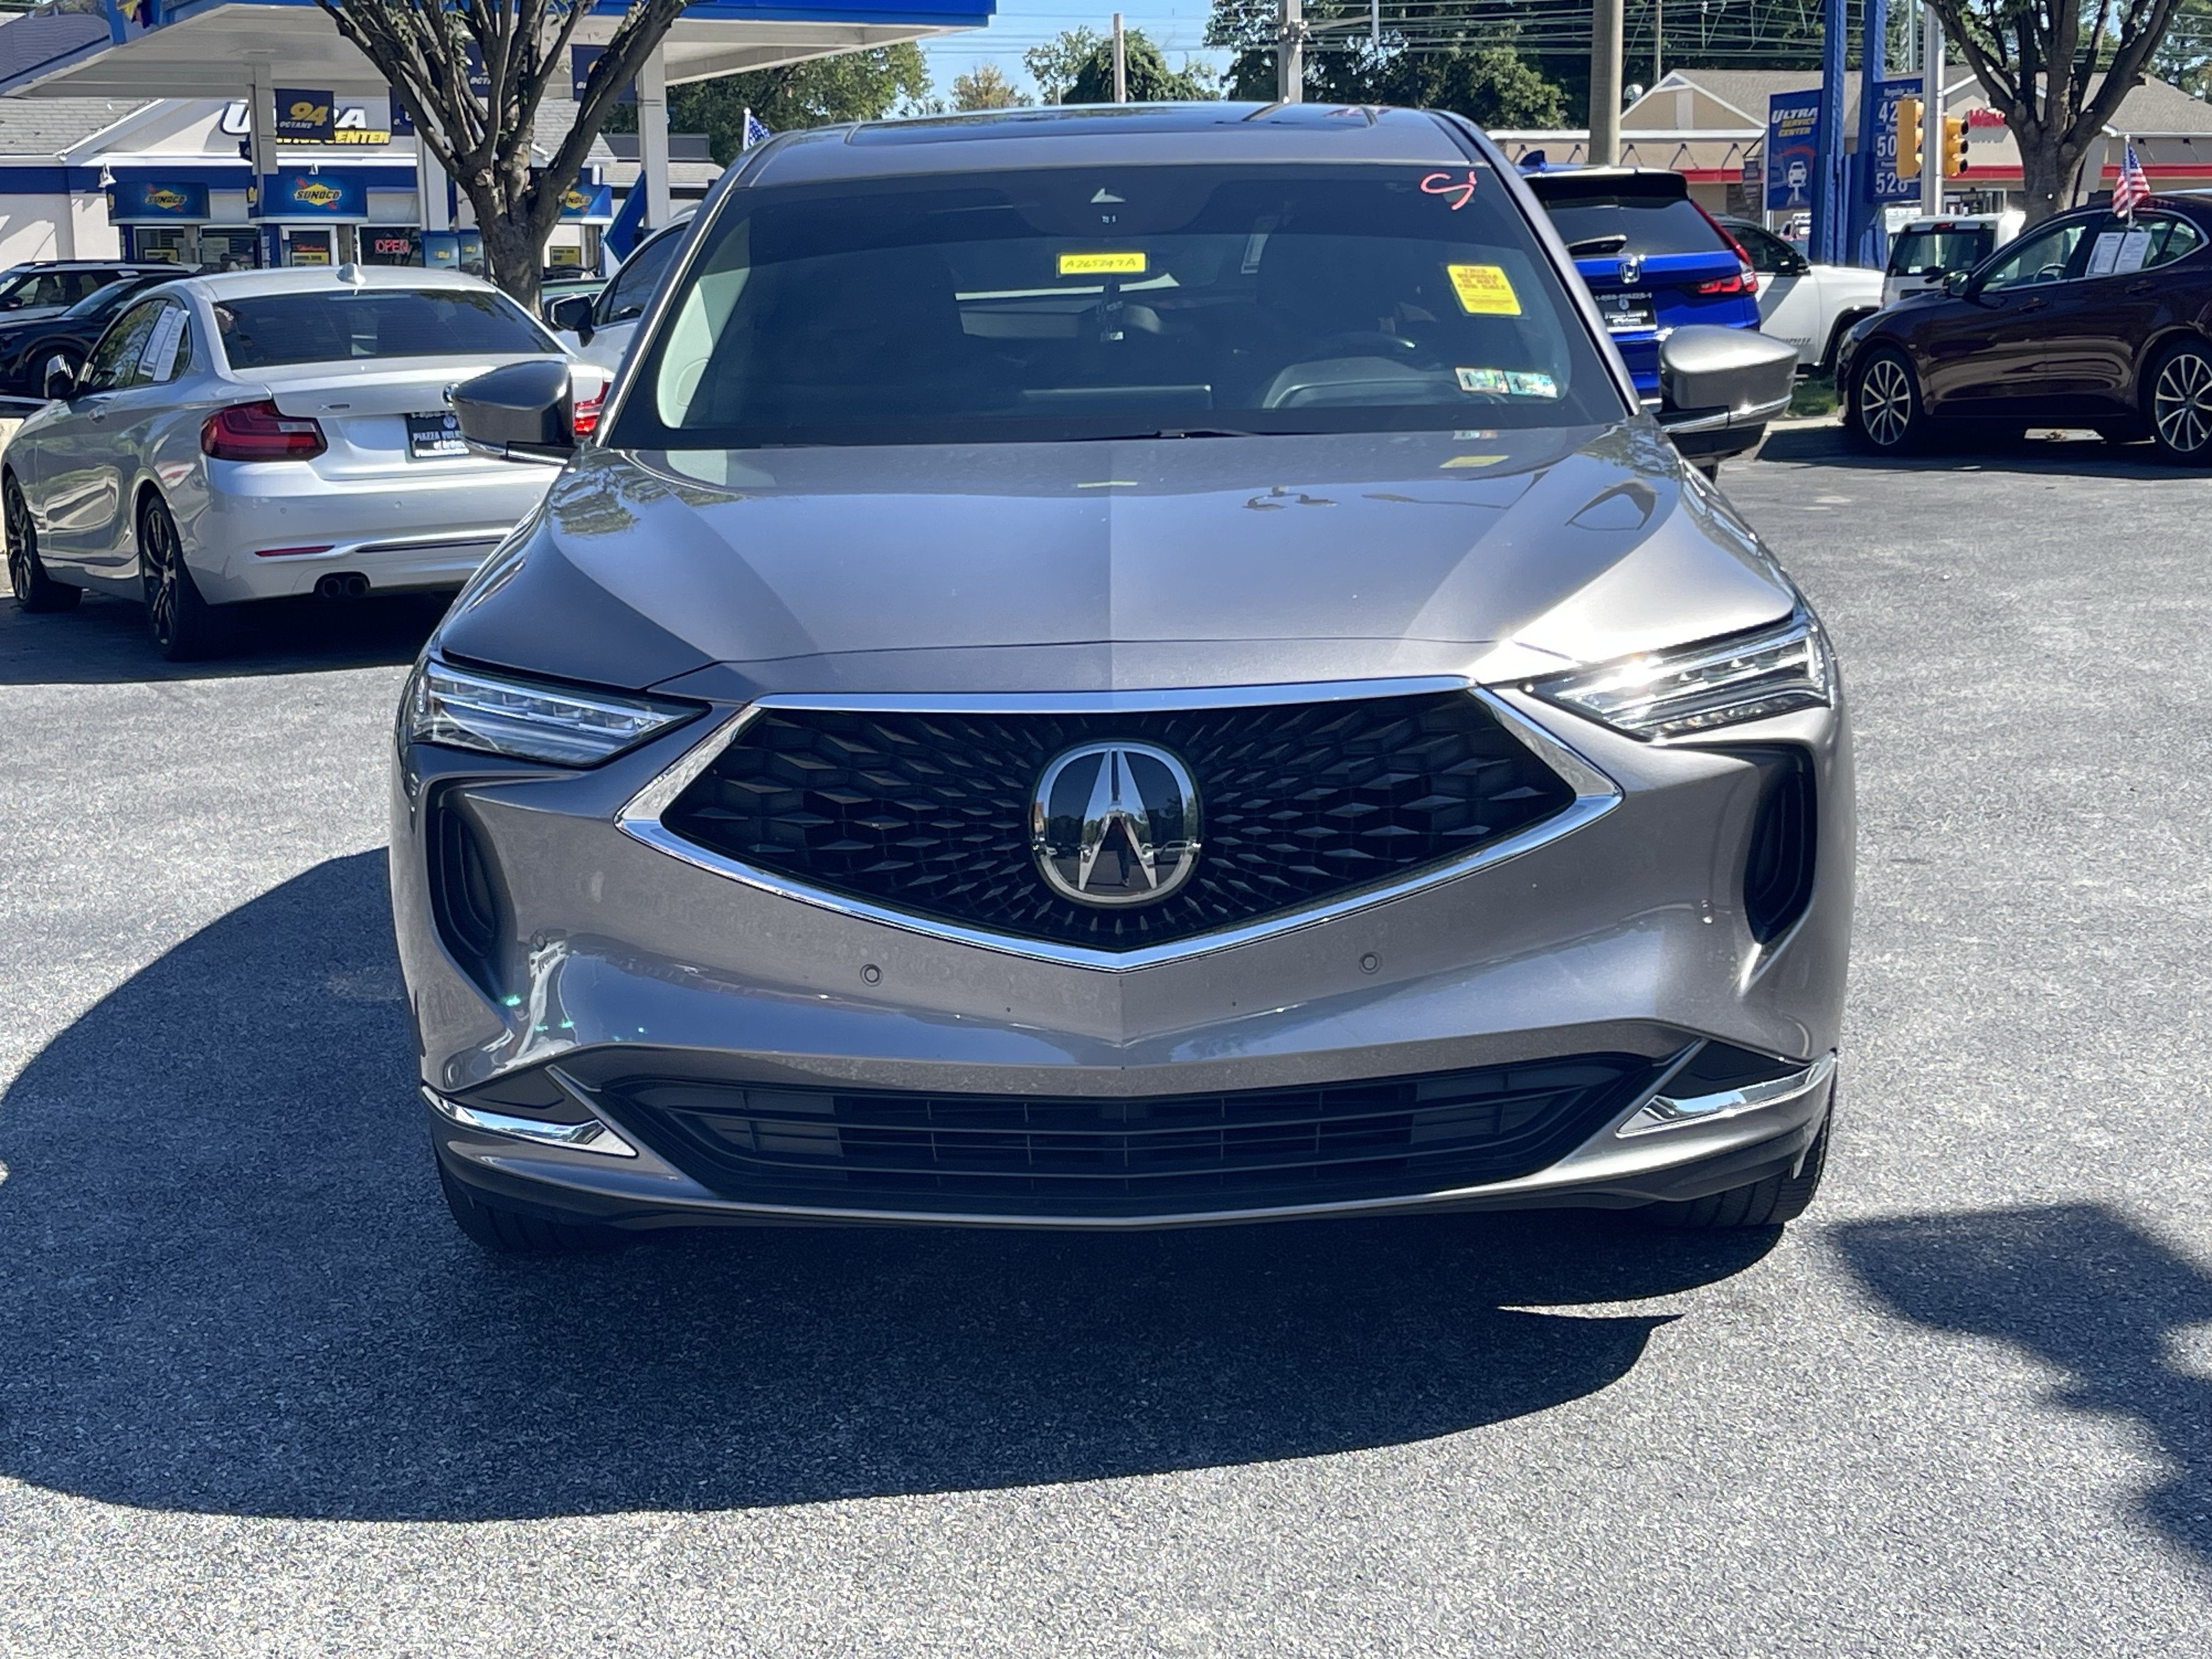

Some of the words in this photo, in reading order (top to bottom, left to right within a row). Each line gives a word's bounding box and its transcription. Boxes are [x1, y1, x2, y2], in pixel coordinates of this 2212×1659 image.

[290, 102, 329, 126] 94
[1771, 107, 1818, 124] ULTRA
[279, 121, 313, 129] OCTANE
[1778, 127, 1812, 137] CENTER
[147, 195, 185, 204] SUNOCO
[297, 190, 340, 199] SUNOCO
[375, 239, 409, 253] OPEN
